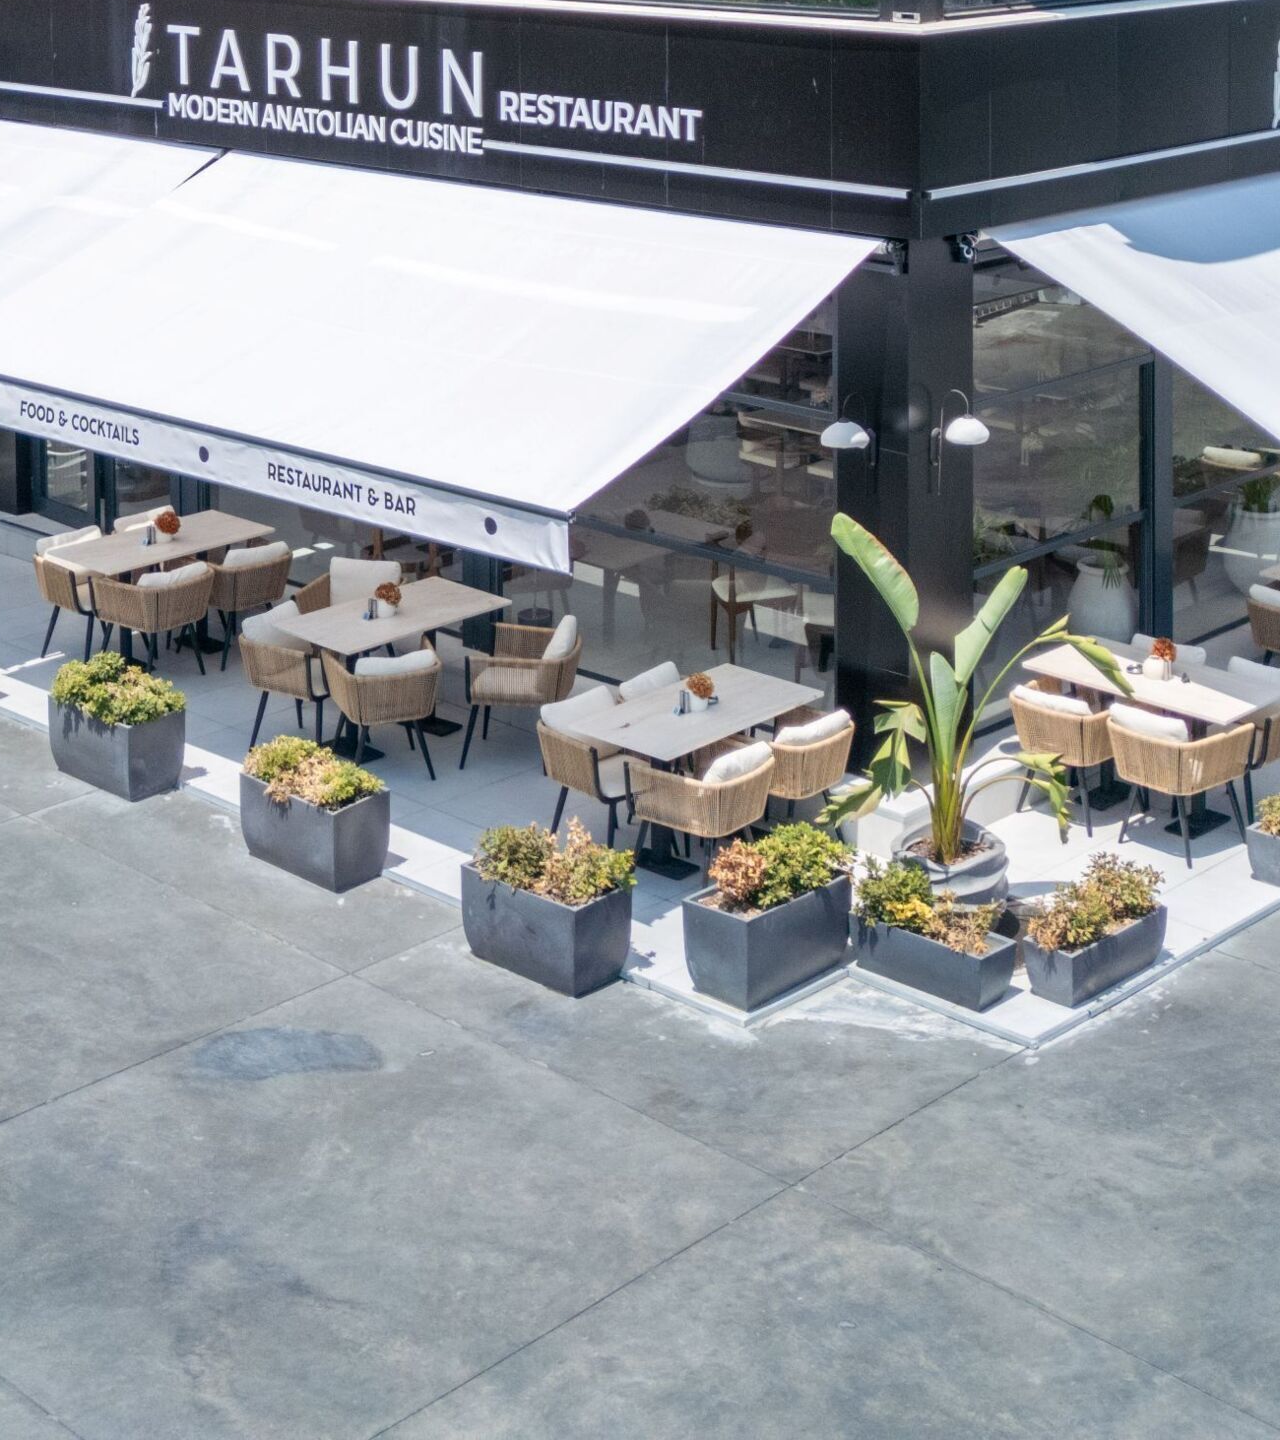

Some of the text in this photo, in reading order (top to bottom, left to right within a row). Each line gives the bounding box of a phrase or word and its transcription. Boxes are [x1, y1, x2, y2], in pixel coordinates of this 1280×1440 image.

[167, 24, 484, 118] TARHUN
[168, 92, 484, 156] MODERN ANATOLIAN CUISINE
[498, 90, 702, 142] RESTAURANT
[20, 400, 140, 446] FOOD & COCKTAILS
[267, 462, 417, 517] RESTAURANT & BAR
